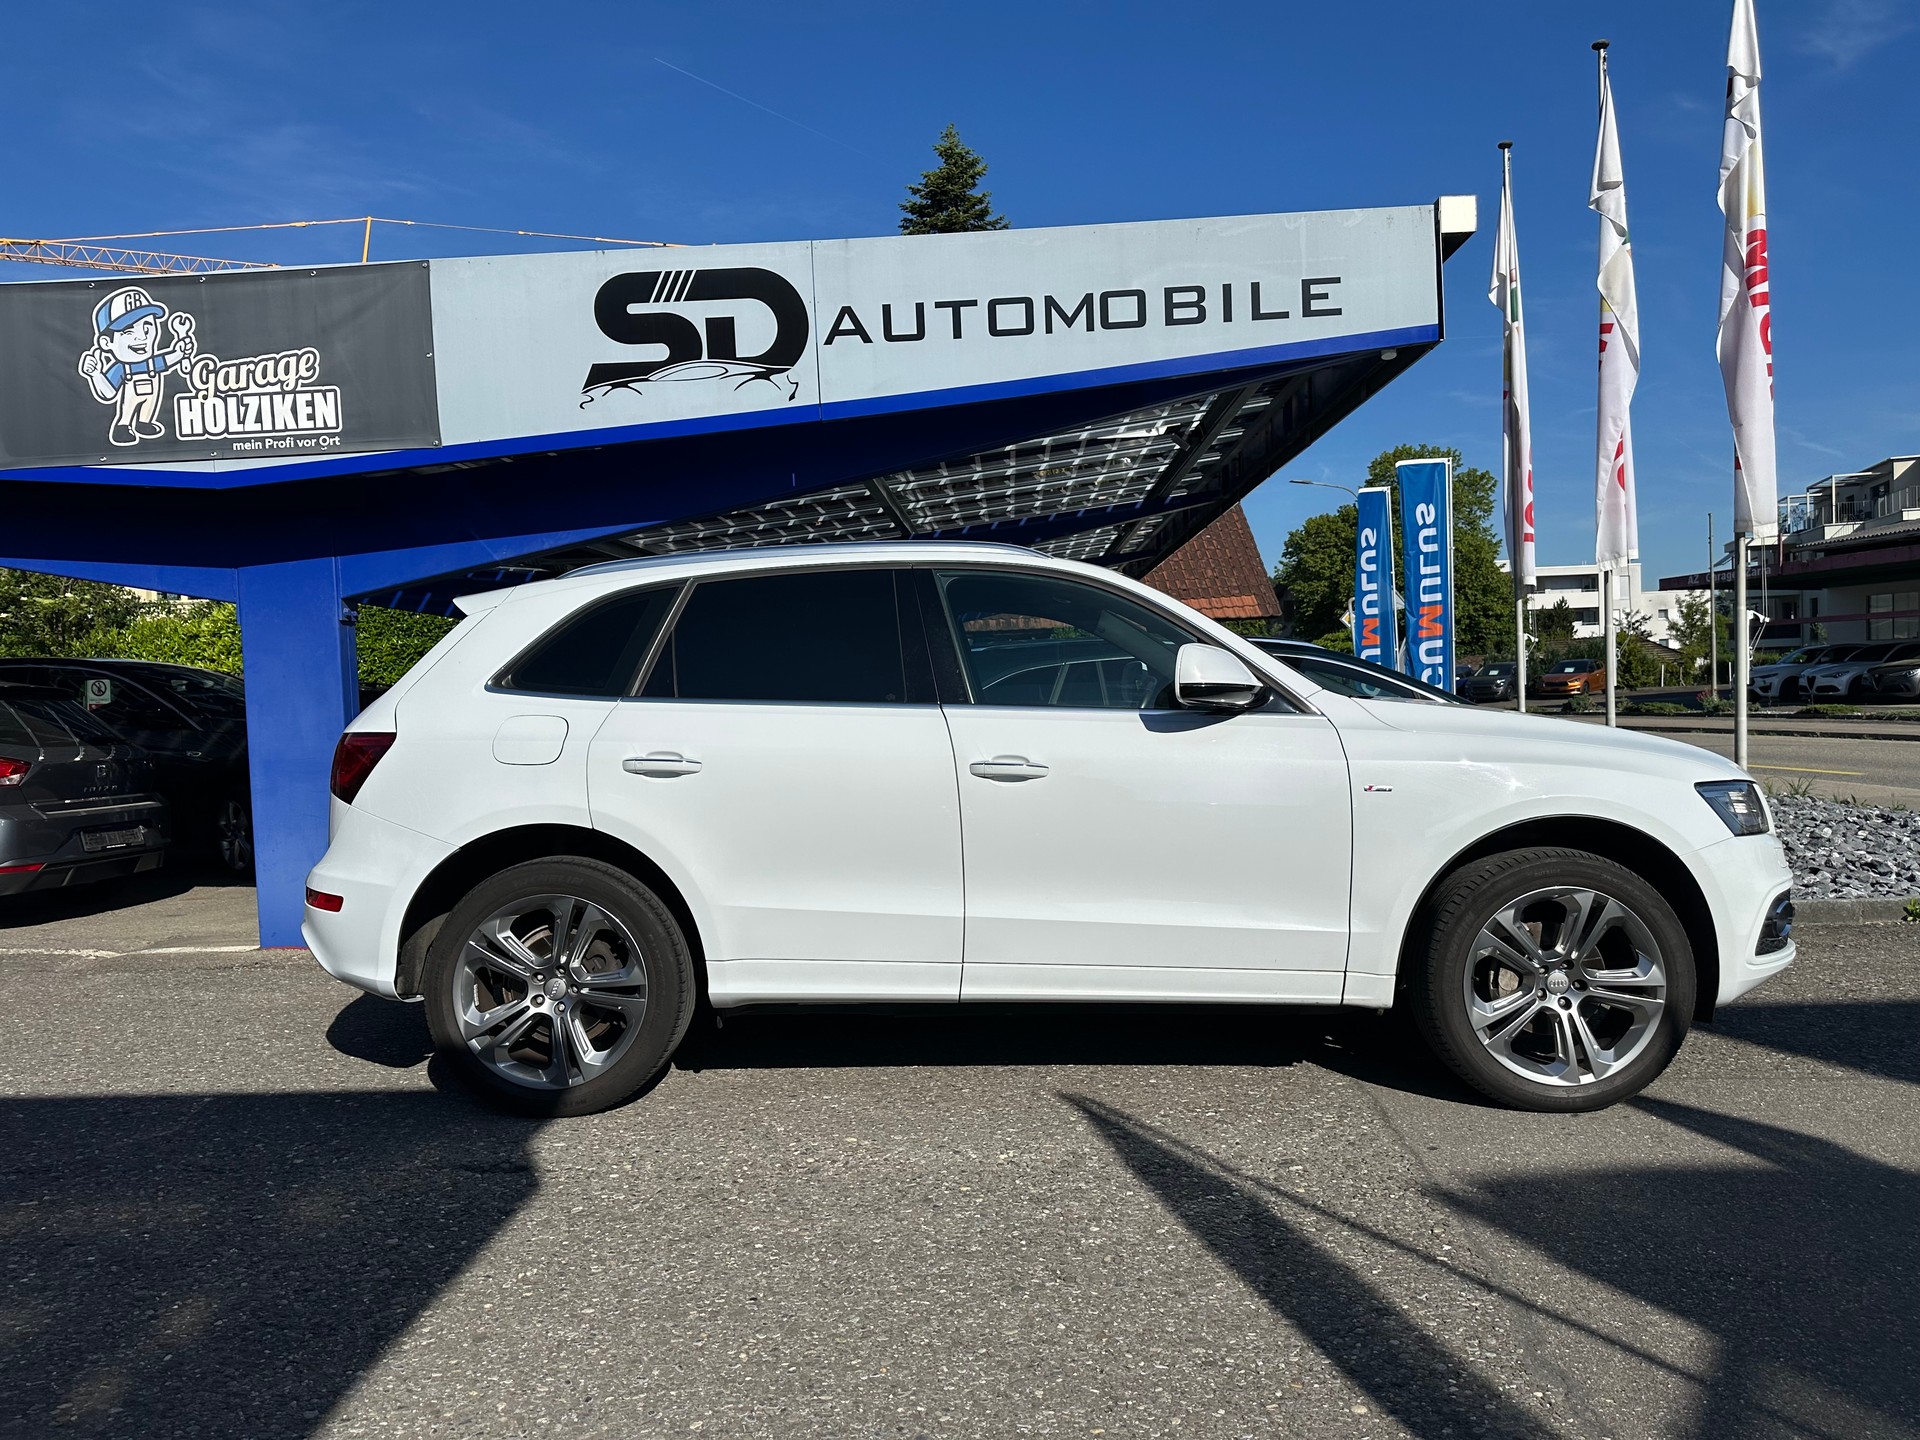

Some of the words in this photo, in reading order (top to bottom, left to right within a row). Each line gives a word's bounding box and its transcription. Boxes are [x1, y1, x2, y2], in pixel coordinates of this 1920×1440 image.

[124, 292, 143, 313] GB
[581, 267, 809, 392] SD
[823, 276, 1343, 346] AUTOMOBILE
[192, 352, 316, 403] Garage
[179, 391, 337, 435] HOLZIKEN
[232, 439, 262, 451] mein
[265, 437, 294, 449] Profi
[297, 438, 317, 448] vor
[319, 435, 341, 447] Ort
